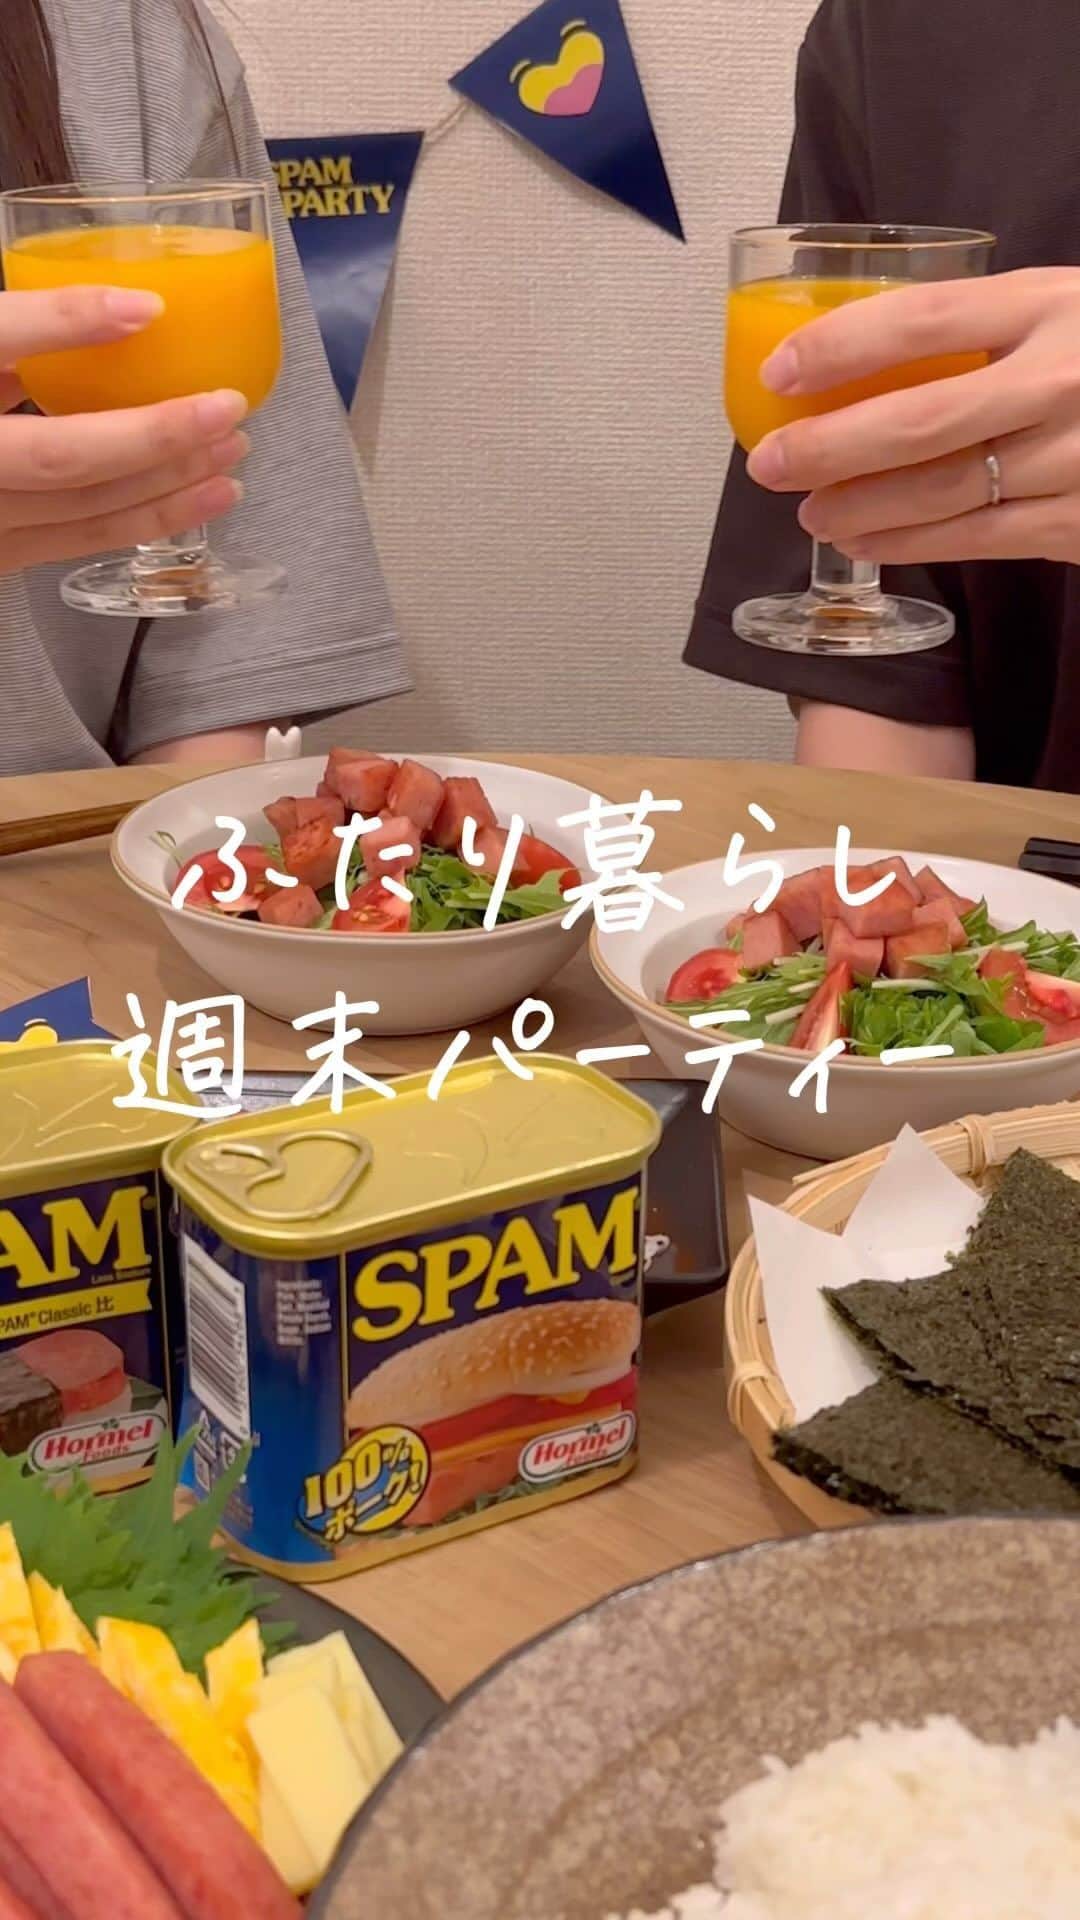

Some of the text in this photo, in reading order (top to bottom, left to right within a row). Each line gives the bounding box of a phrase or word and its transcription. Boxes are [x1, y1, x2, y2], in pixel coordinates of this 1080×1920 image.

[281, 184, 395, 219] PARTY
[352, 1187, 639, 1342] SPAM
[38, 1302, 92, 1325] Classic
[44, 1418, 154, 1460] Hormel
[533, 1419, 627, 1465] Hormel
[304, 1437, 412, 1518] 100%
